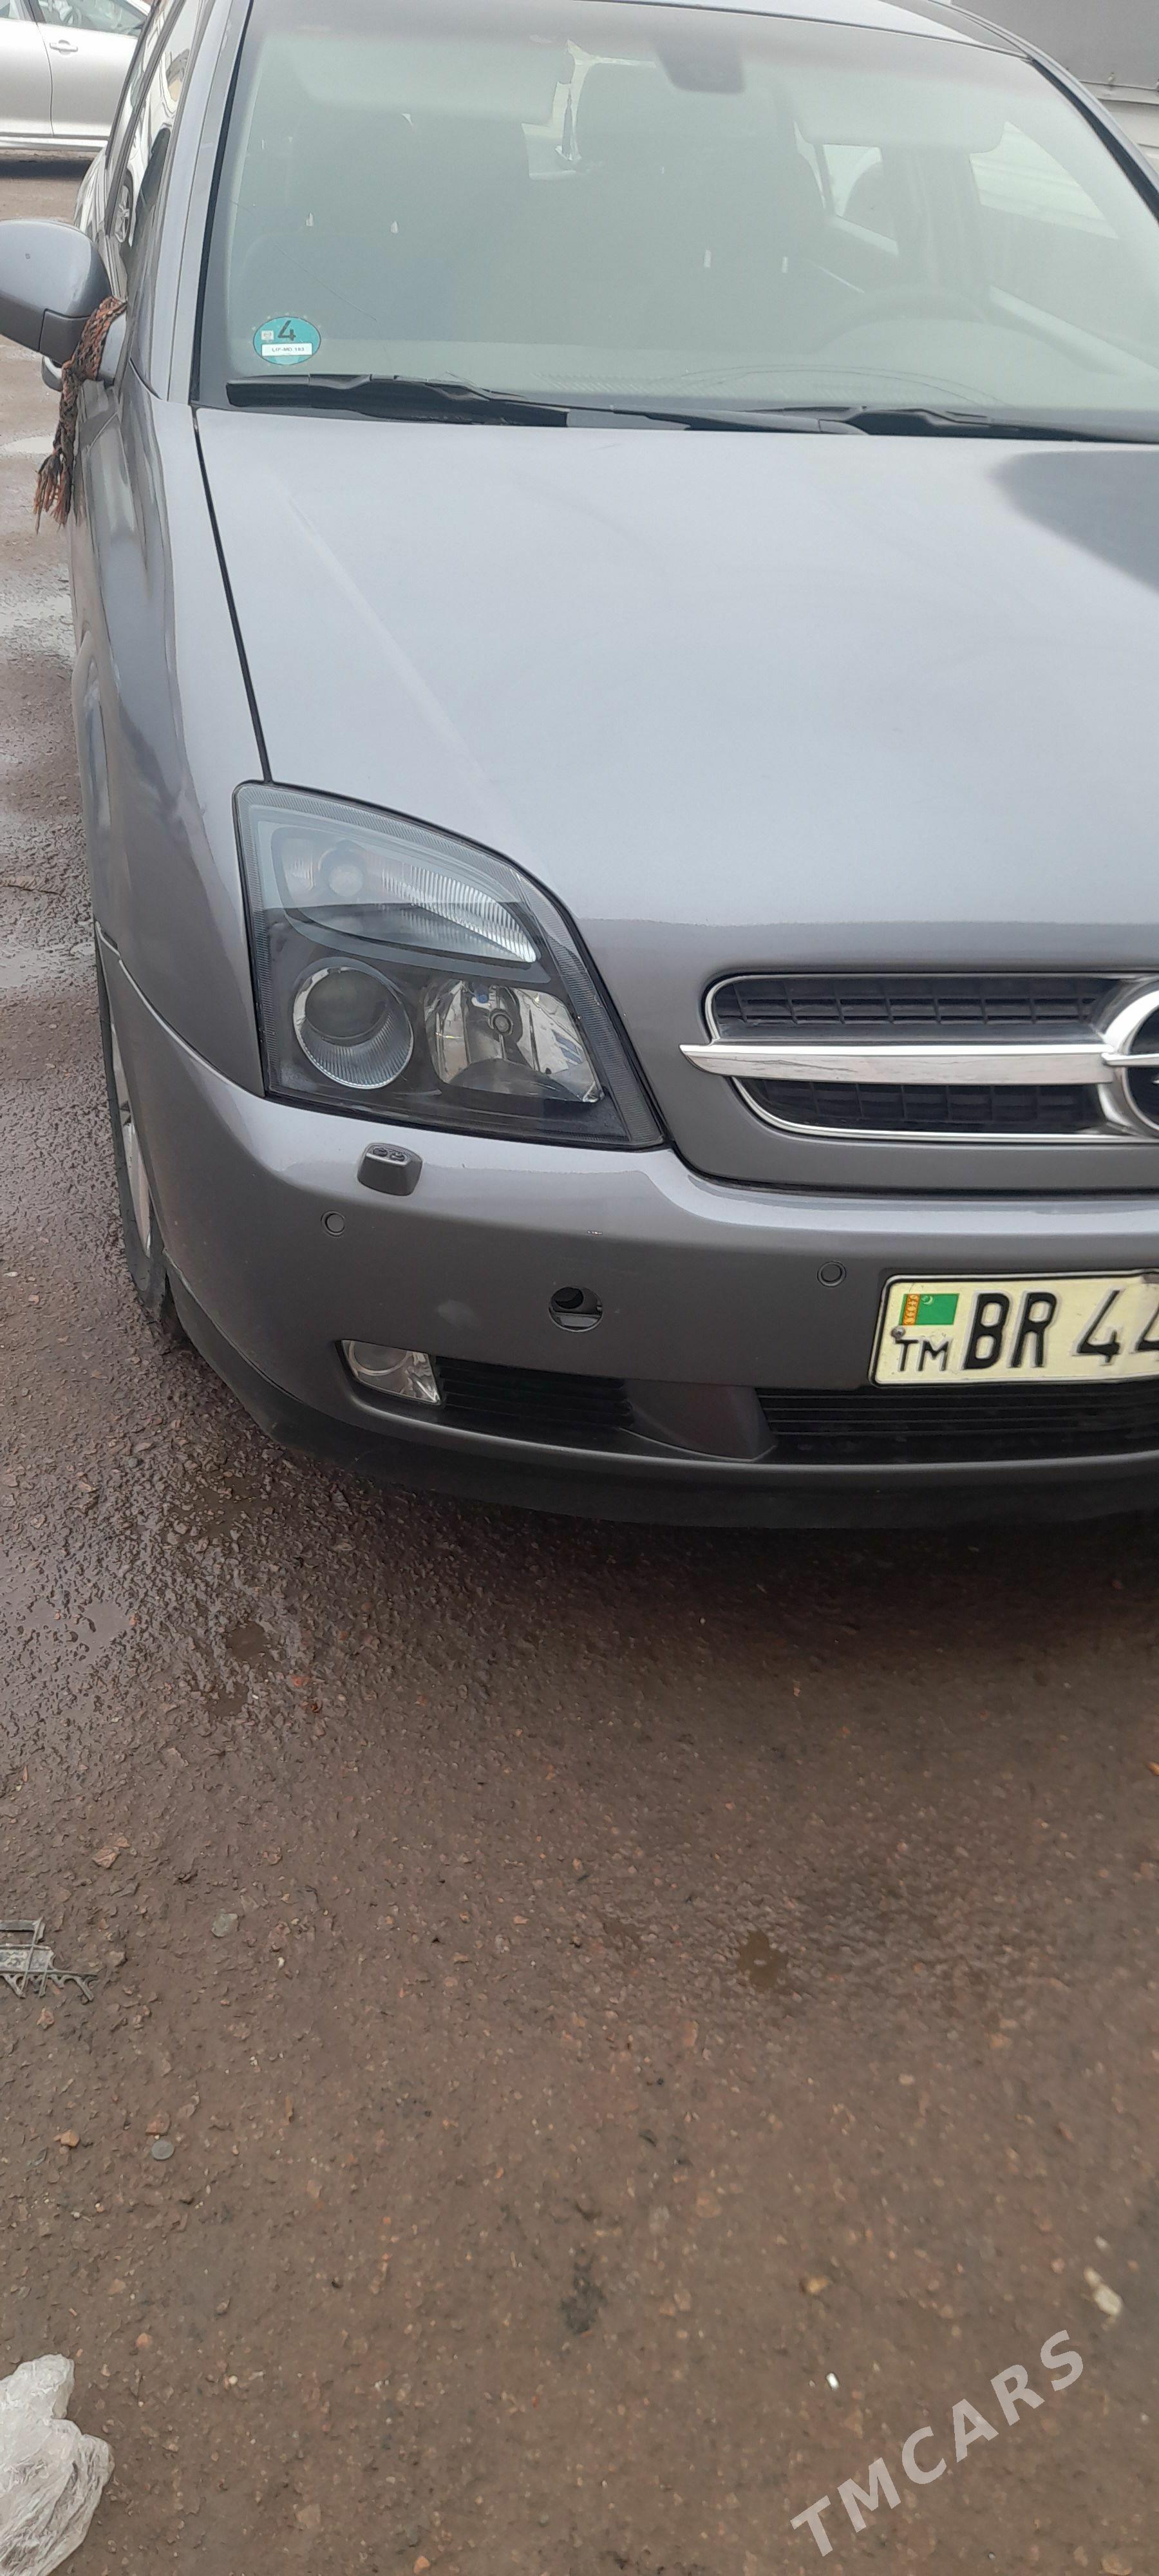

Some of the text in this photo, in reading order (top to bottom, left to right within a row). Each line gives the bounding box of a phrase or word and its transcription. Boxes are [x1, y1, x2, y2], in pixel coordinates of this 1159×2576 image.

[278, 320, 296, 341] 4
[963, 1292, 1057, 1370] BR
[896, 1339, 951, 1371] TM
